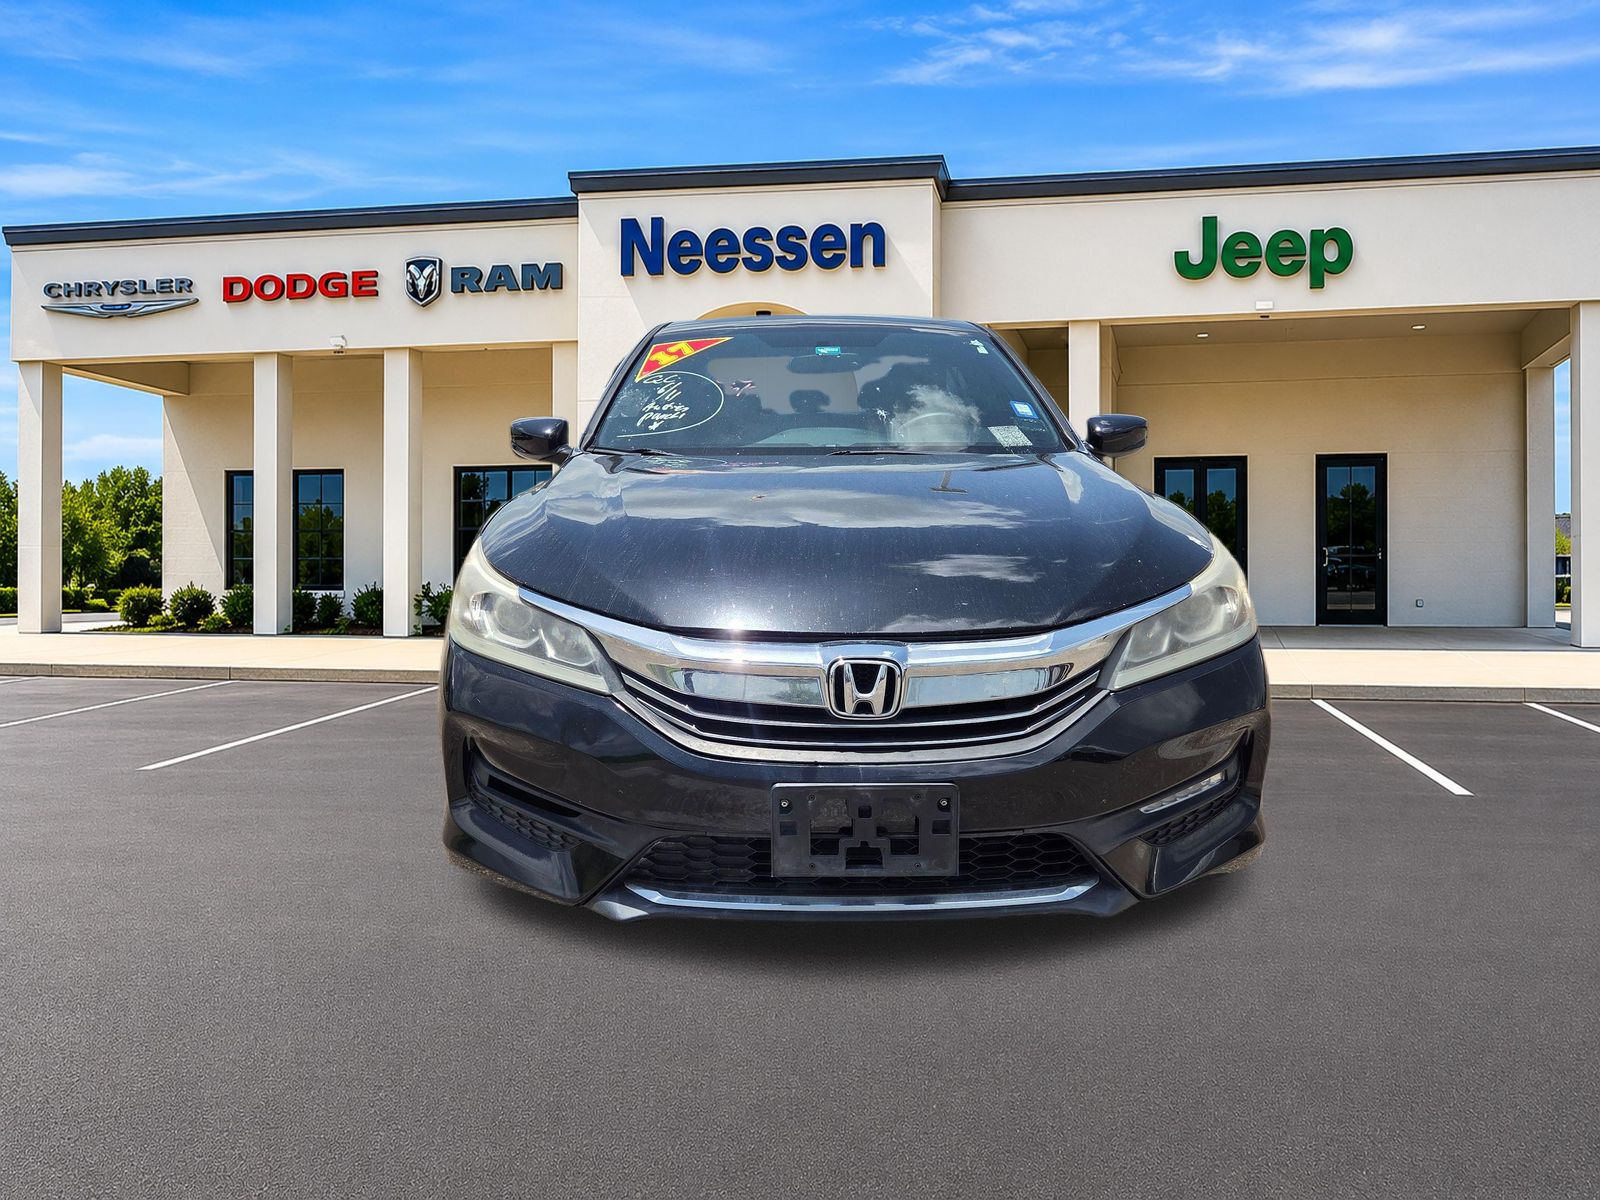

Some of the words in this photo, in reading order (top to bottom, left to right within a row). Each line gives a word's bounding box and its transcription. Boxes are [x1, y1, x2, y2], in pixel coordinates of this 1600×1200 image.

[620, 216, 886, 277] Neessen
[1174, 215, 1354, 290] Jeep
[43, 277, 194, 299] CHRYSLER
[222, 269, 379, 304] DODGE
[450, 262, 564, 294] RAM
